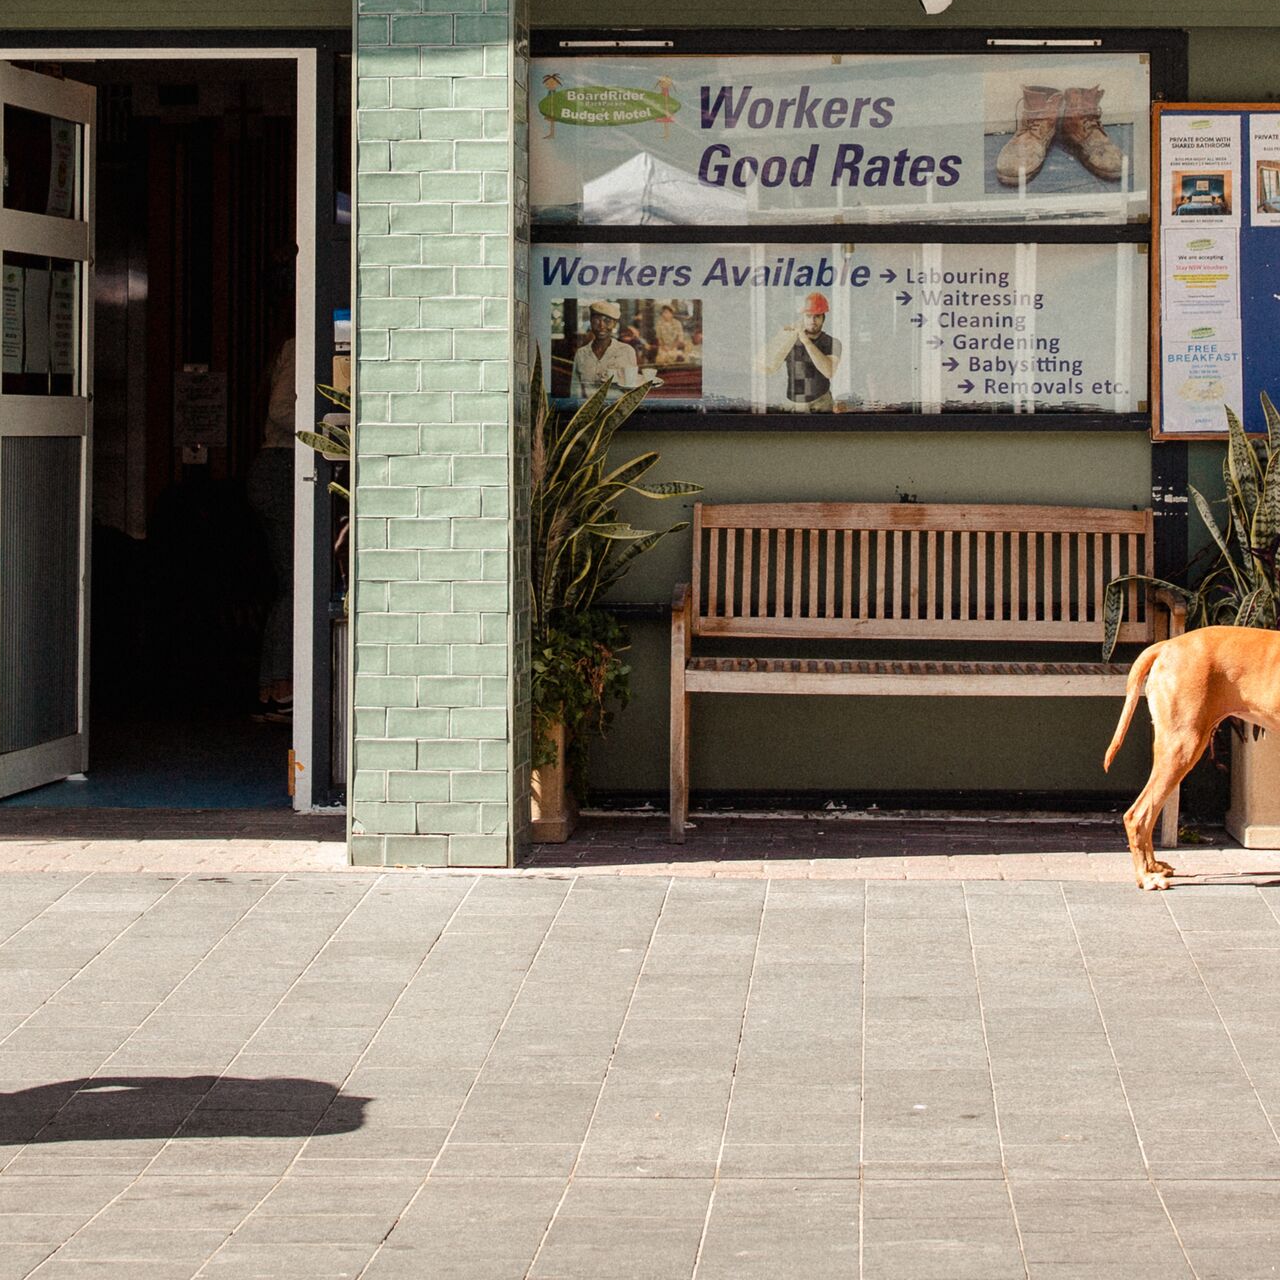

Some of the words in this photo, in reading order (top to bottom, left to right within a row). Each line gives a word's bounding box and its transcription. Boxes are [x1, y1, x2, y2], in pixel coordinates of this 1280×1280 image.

[567, 90, 645, 101] BoardRider
[561, 108, 609, 122] Budget
[613, 107, 651, 121] Motel
[699, 85, 896, 130] Workers
[698, 143, 819, 188] Good
[831, 146, 963, 188] Rates
[541, 256, 692, 287] Workers
[702, 256, 871, 287] Available
[906, 268, 1010, 290] Labouring
[921, 290, 1044, 311] Waitressing
[937, 312, 1027, 333] Cleaning
[952, 334, 1061, 355] Gardening
[1187, 344, 1217, 353] FREE
[968, 355, 1083, 377] Babysitting
[1167, 352, 1239, 363] BREAKFAST
[984, 377, 1084, 396] Removals
[1091, 379, 1131, 396] etc.
